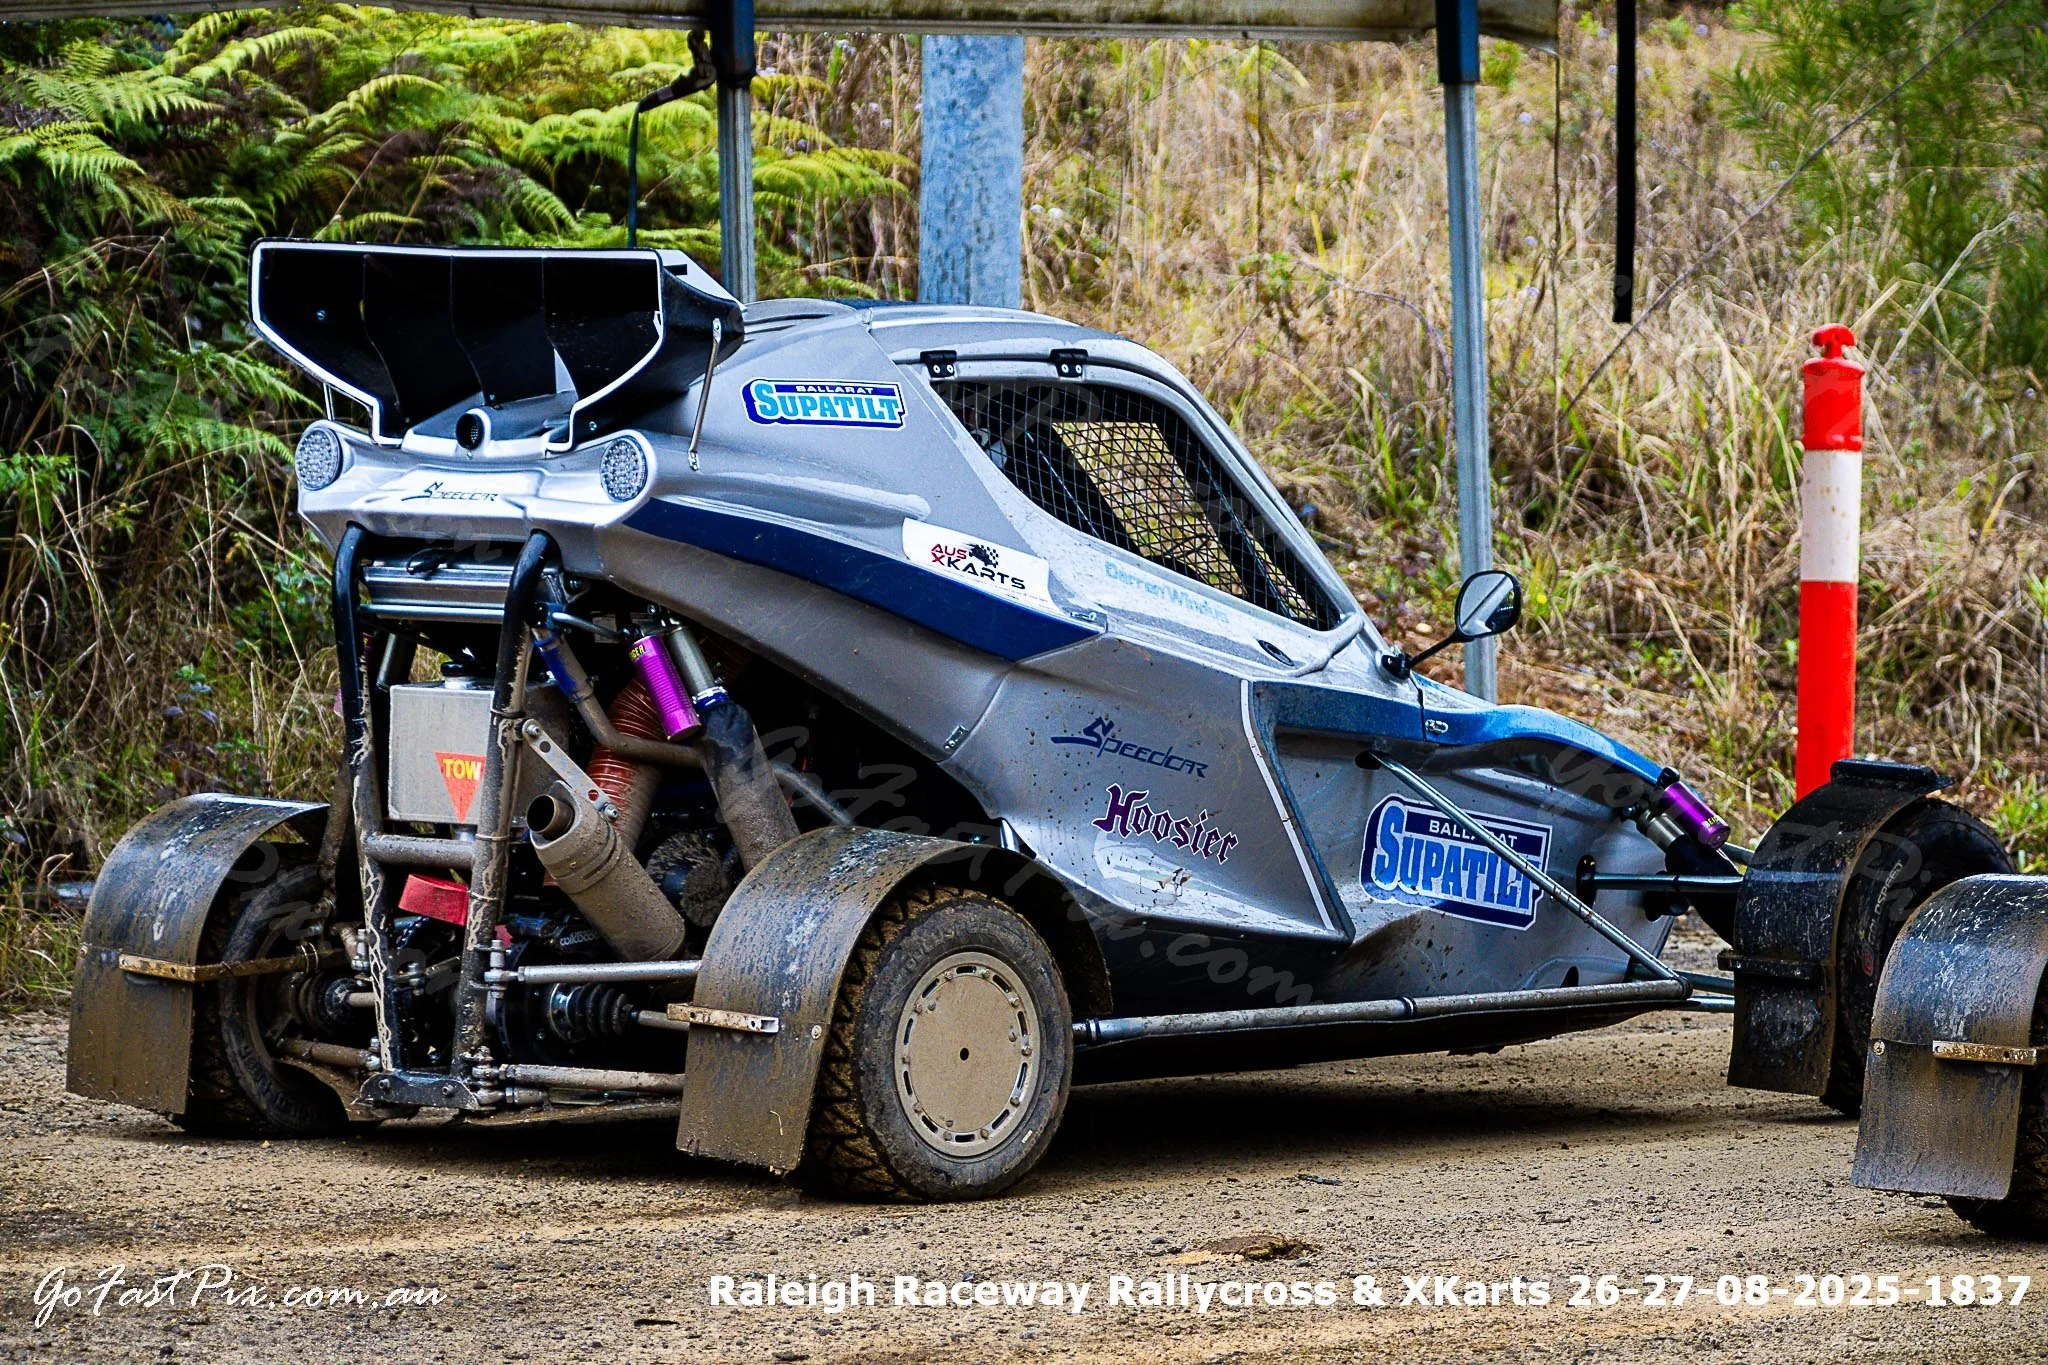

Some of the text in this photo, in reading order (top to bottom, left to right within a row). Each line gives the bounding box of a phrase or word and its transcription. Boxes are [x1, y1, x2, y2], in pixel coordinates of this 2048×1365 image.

[755, 383, 899, 421] SUPATILT
[796, 385, 874, 395] BALLARAT
[931, 543, 968, 561] AUS
[931, 552, 1026, 590] XKARTS
[442, 758, 482, 780] TOW
[1091, 783, 1239, 865] Hoosier
[1429, 819, 1518, 848] BALLAT
